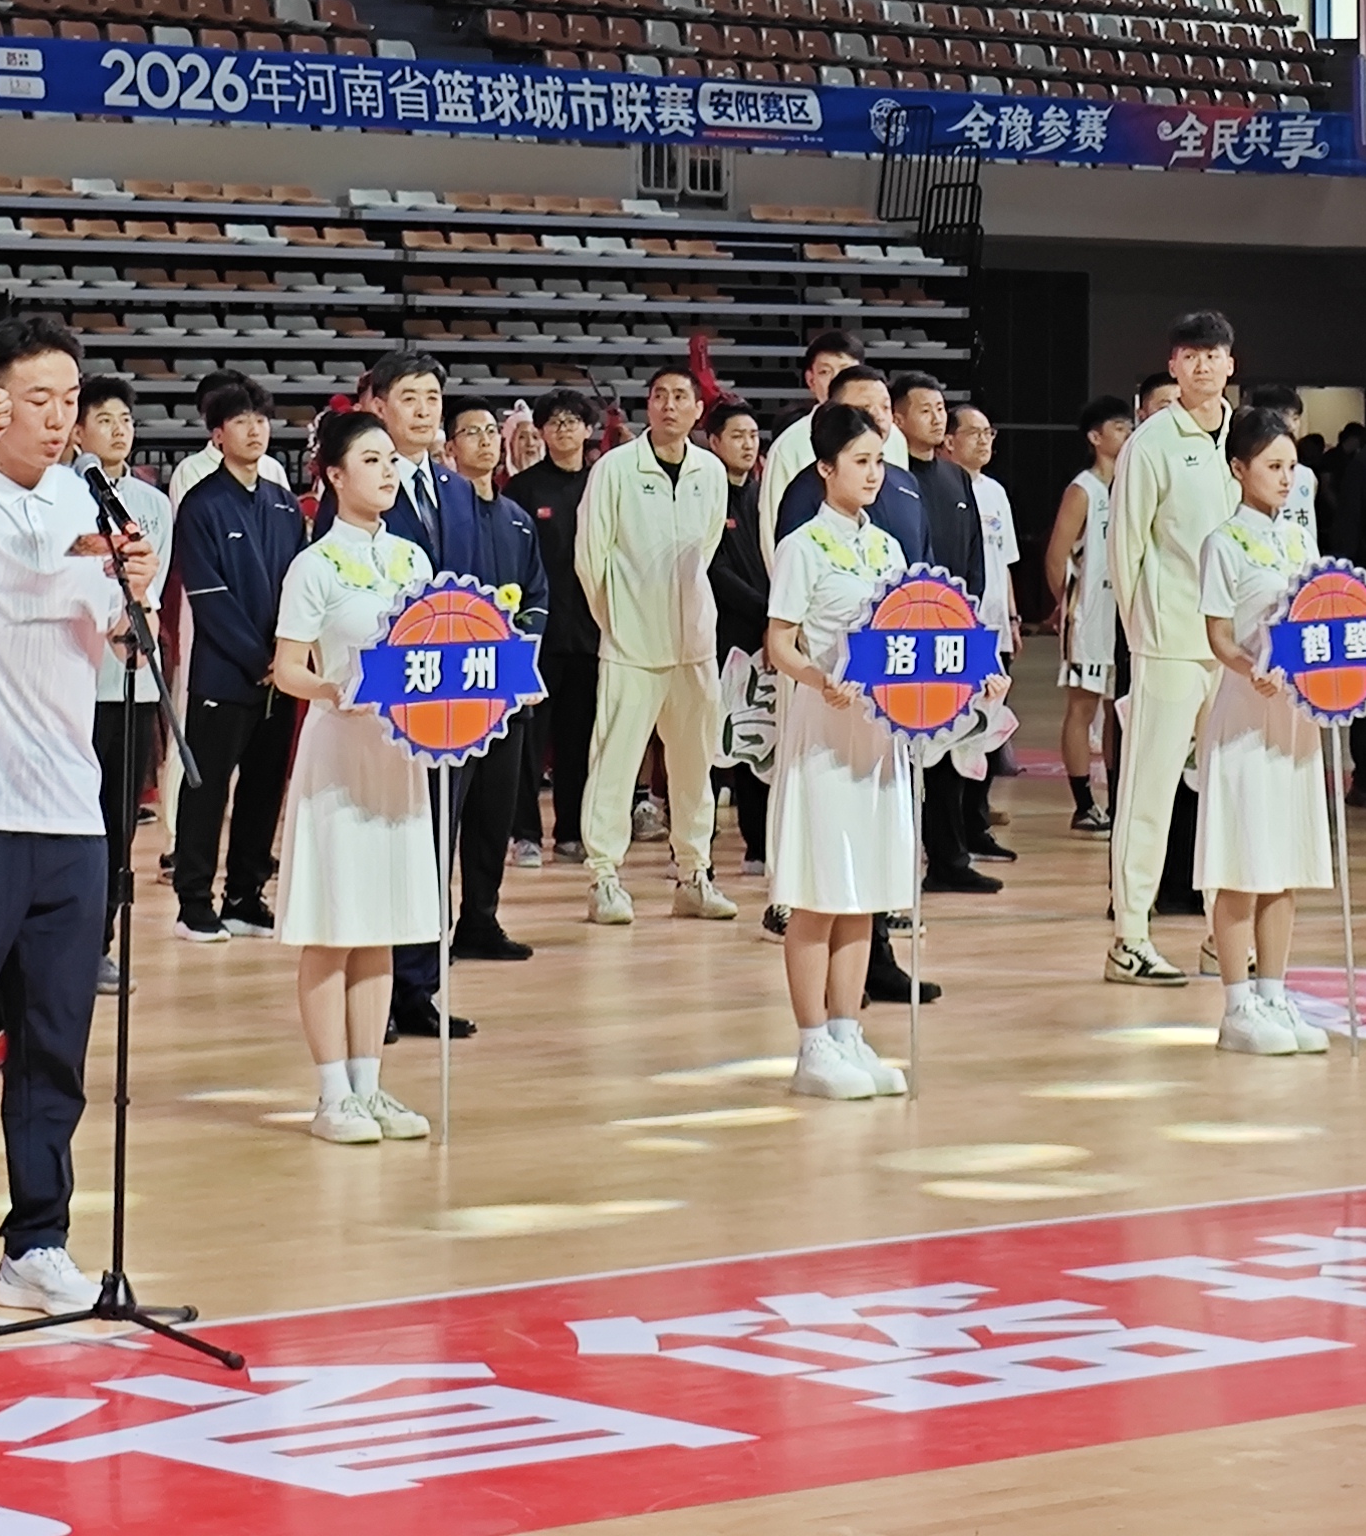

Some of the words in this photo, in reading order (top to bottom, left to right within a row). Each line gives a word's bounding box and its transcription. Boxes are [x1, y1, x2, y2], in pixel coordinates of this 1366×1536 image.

[101, 48, 697, 138] 2026年河南省篮球城市联赛
[709, 89, 814, 125] 安阳赛区
[946, 100, 1115, 156] 全豫参赛
[1157, 110, 1331, 170] 全民共享
[404, 646, 496, 694] 郑州
[885, 635, 965, 675] 洛阳
